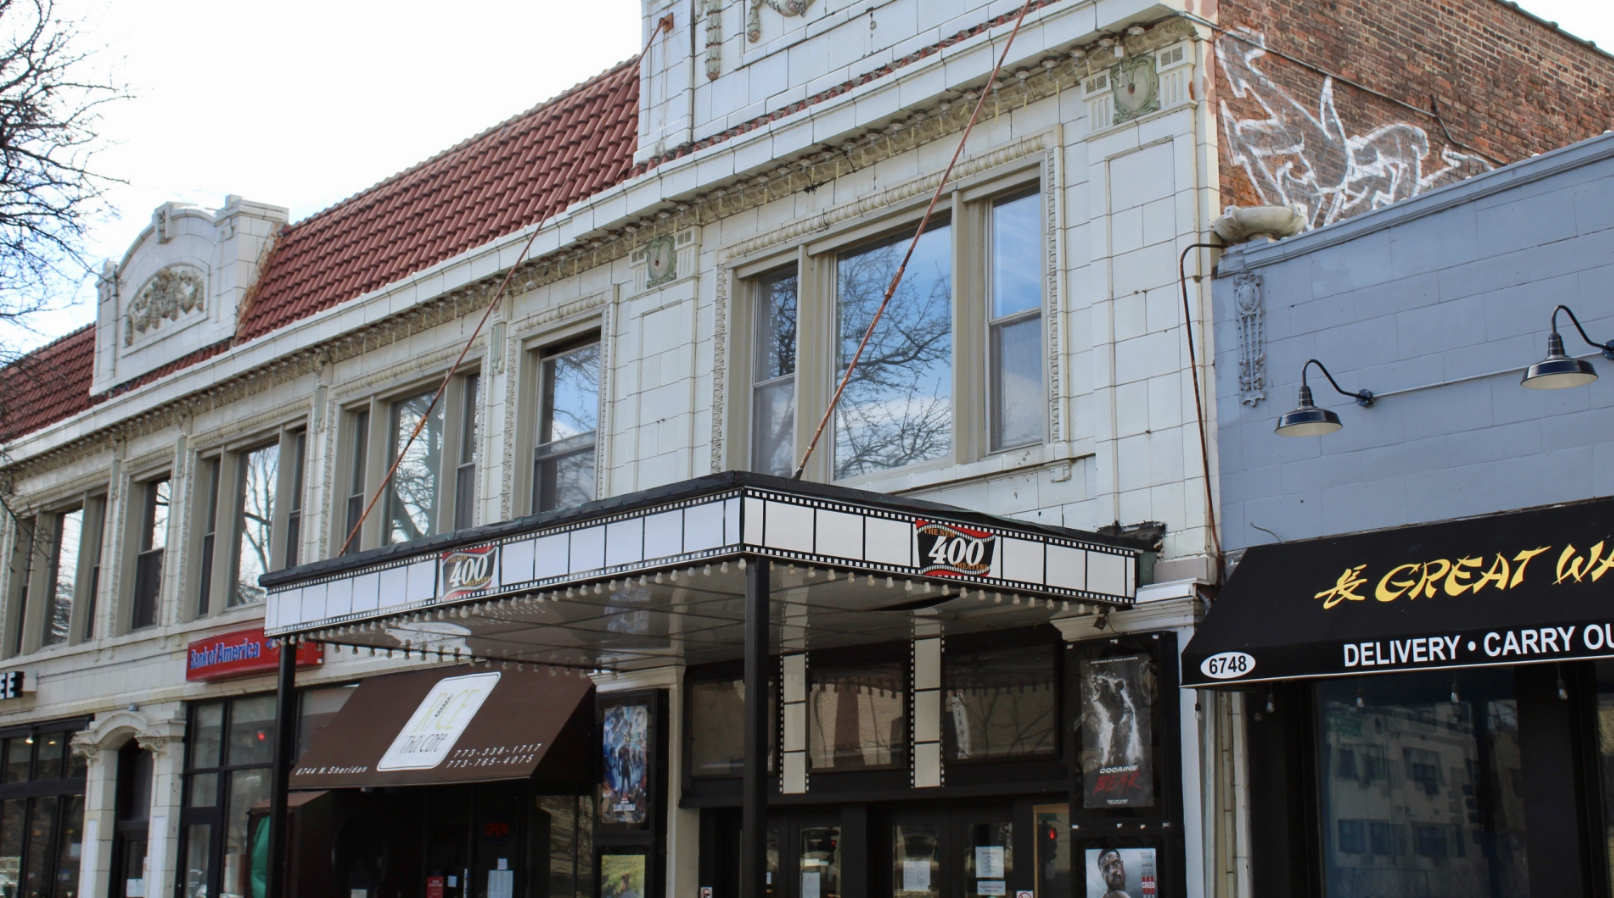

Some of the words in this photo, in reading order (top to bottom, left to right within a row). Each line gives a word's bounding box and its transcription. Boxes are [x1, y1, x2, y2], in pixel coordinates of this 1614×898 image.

[940, 529, 955, 538] NEW
[928, 535, 984, 566] 400
[449, 555, 488, 588] 400
[1375, 546, 1551, 602] GREAT
[190, 645, 207, 670] Bank
[208, 643, 218, 665] of
[218, 638, 260, 663] America
[1343, 635, 1461, 667] DELIVERY
[1483, 626, 1575, 657] CARRY
[1209, 655, 1247, 675] 6748
[454, 743, 542, 758] 773-338-1717
[296, 767, 317, 776] 6744
[446, 754, 534, 769] 773-765-4075
[1100, 765, 1138, 774] COCAINE
[1092, 771, 1144, 797] BEAR
[485, 822, 508, 836] OPEN
